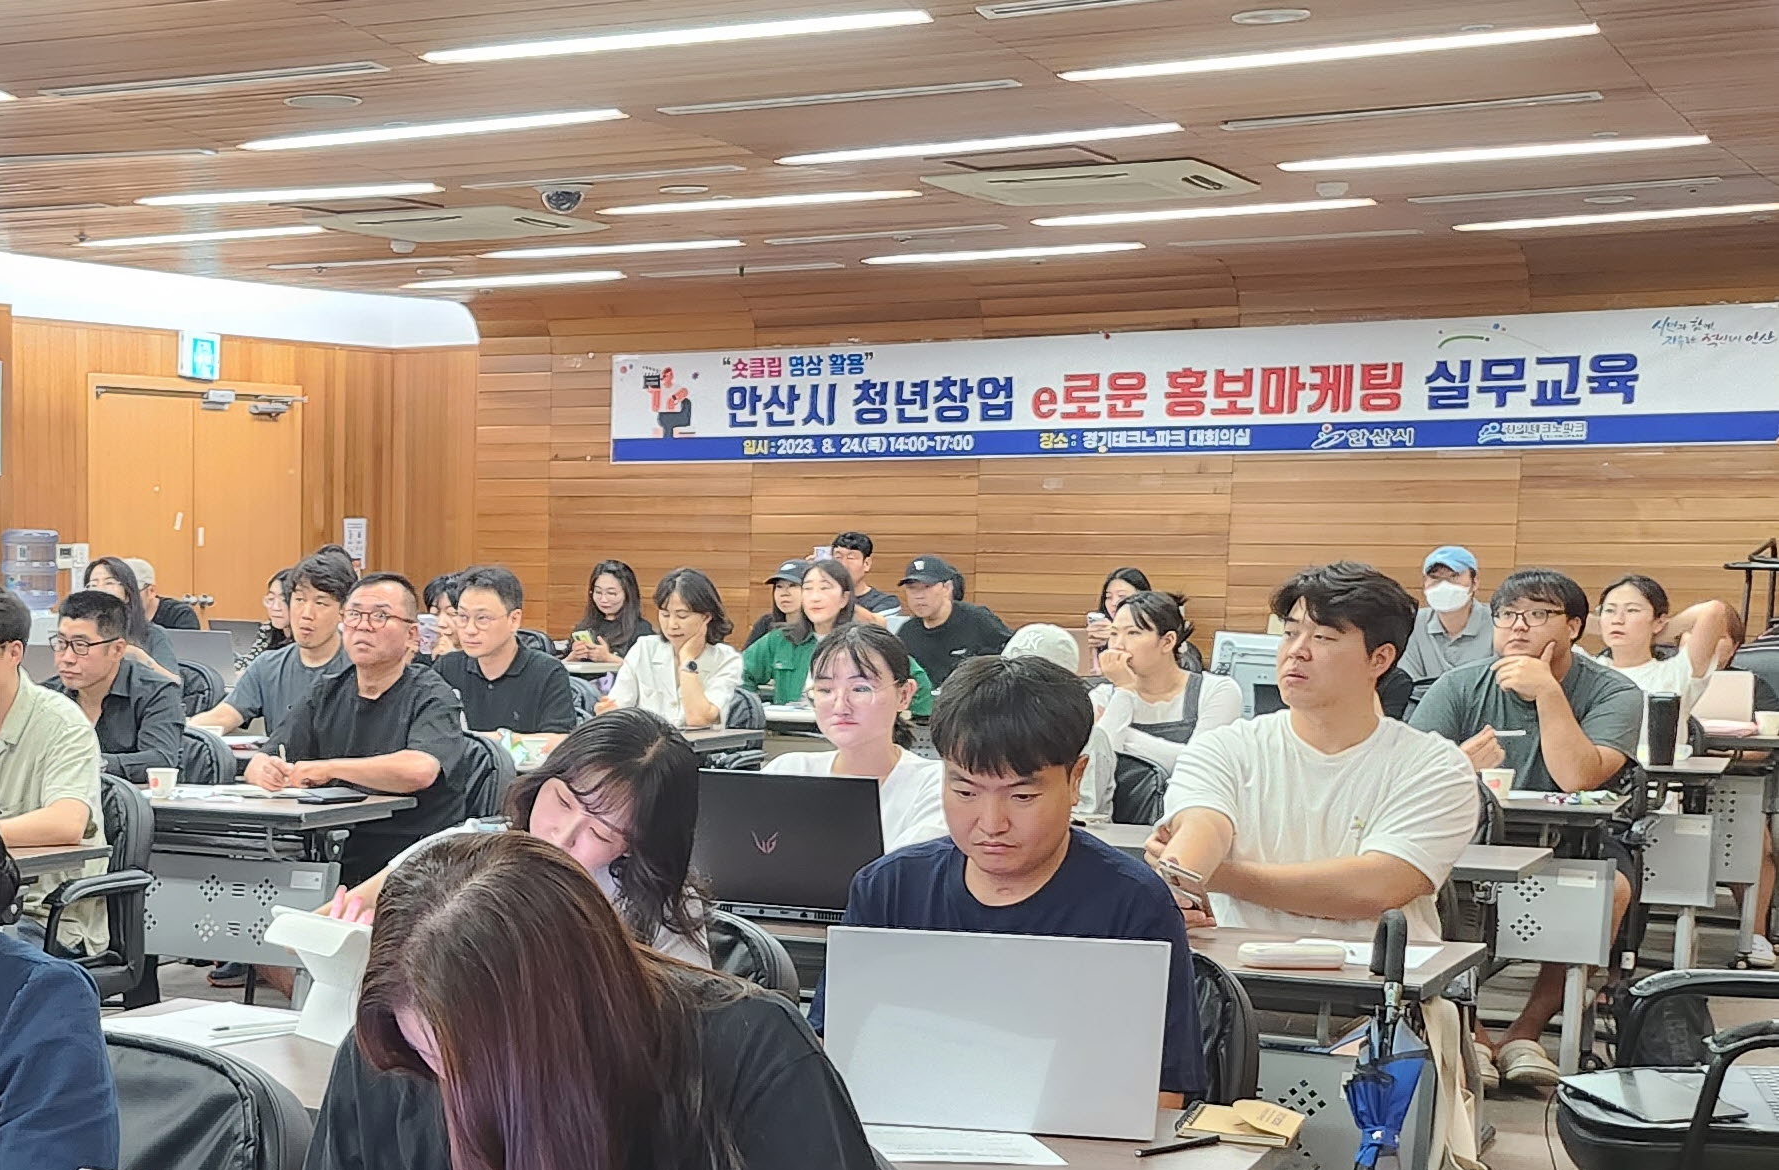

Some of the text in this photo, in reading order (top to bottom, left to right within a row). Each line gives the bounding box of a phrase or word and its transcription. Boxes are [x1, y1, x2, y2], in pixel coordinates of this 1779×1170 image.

[1745, 331, 1778, 345] 안산
[789, 355, 824, 378] 영상
[726, 353, 1639, 428] 안산시 청년창업 e로운 홍보마케팅 실무교육
[1083, 430, 1186, 449] 경기테크노파크
[1188, 428, 1251, 447] 대회의실
[1346, 427, 1415, 446] 안산시
